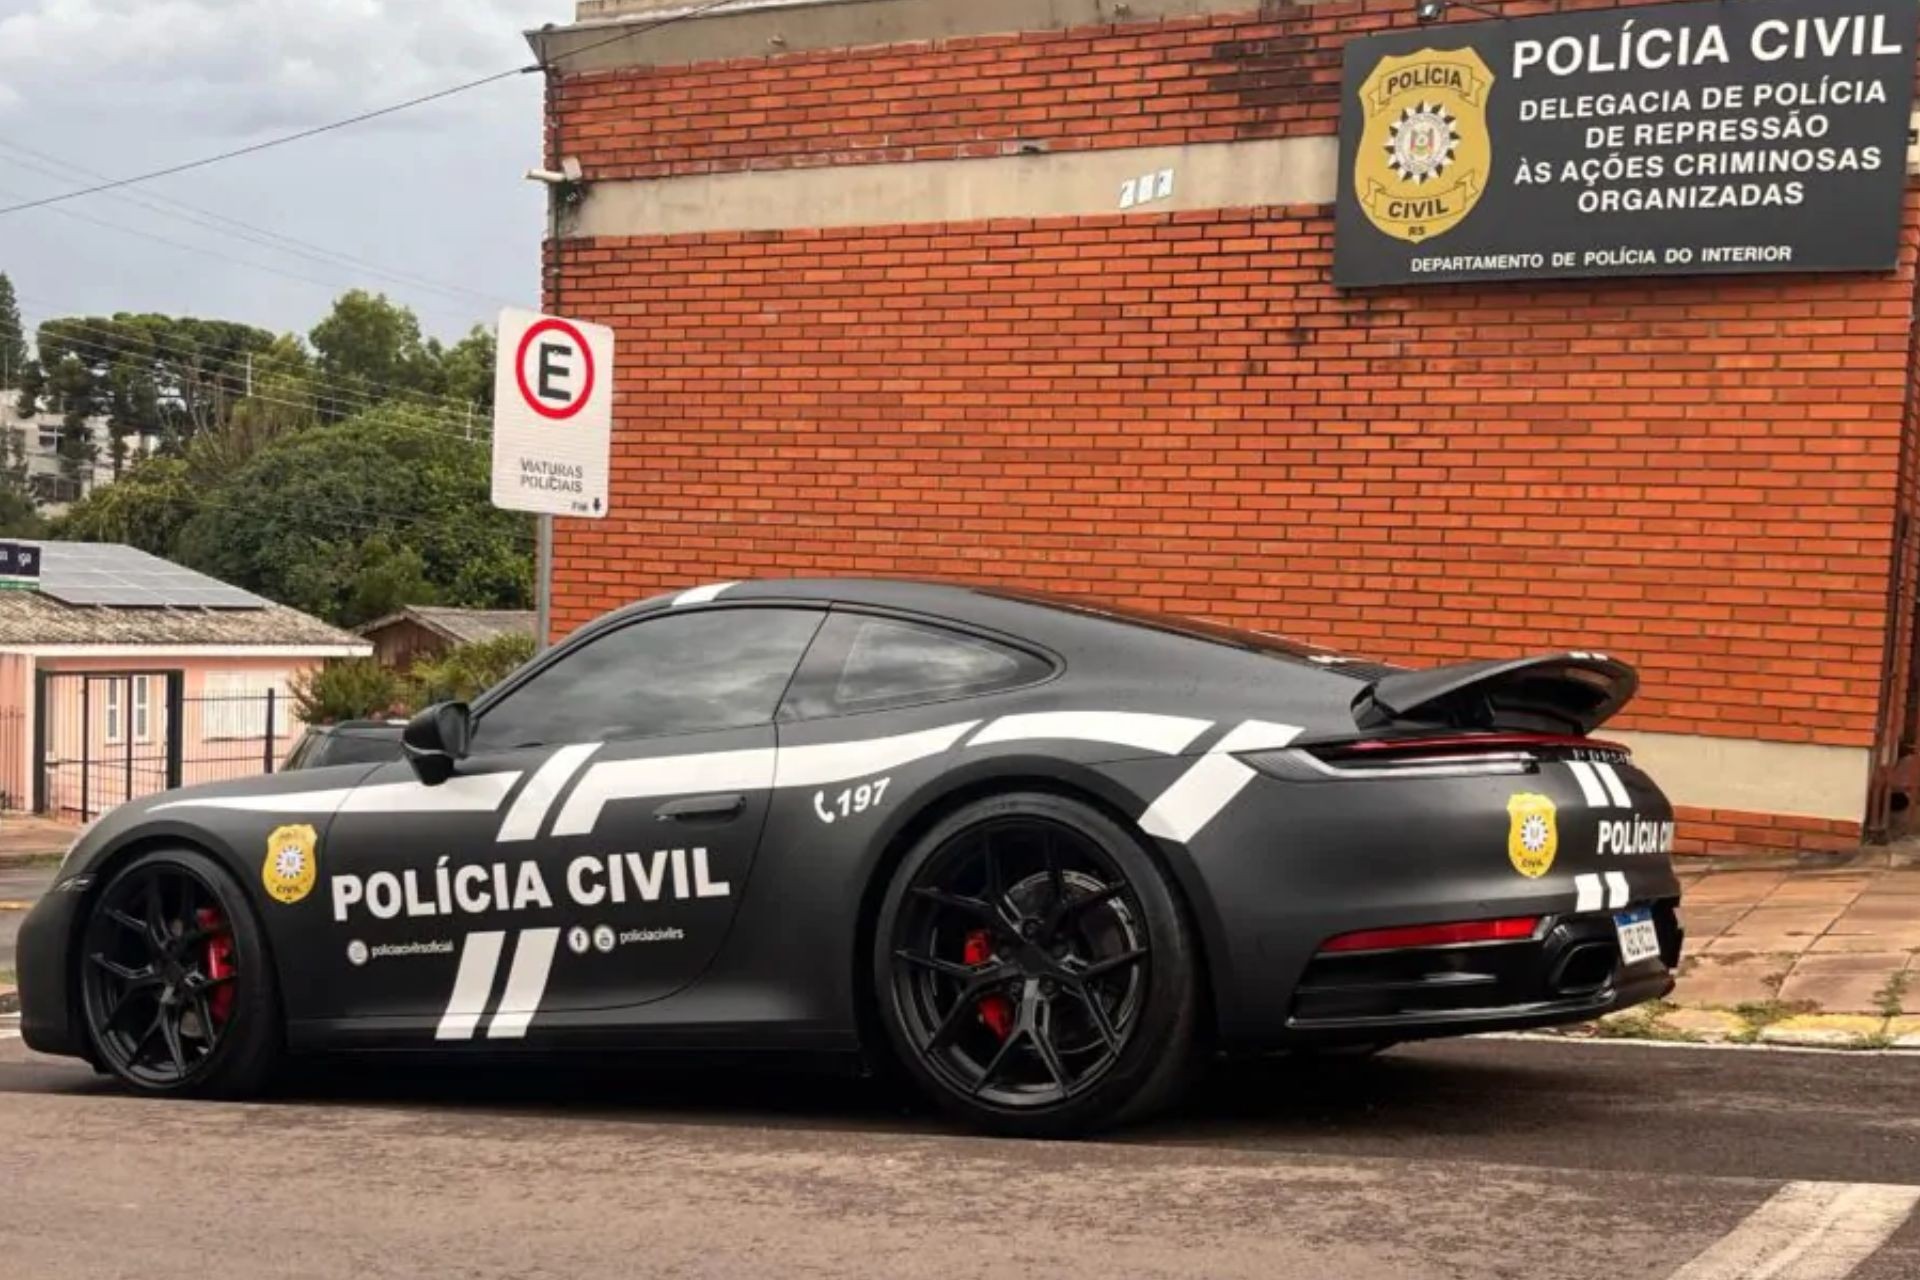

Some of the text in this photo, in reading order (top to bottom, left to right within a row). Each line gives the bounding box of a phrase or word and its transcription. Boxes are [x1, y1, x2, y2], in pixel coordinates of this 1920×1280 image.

[1512, 14, 1902, 79] POLÍCIA CIVIL
[1387, 65, 1463, 95] POLÍCIA
[1519, 74, 1886, 120] DELEGACIA DE POLÍCIA
[1585, 110, 1829, 149] DE REPRESSÃO
[1514, 146, 1881, 187] ÀS AÇÕES CRIMINOSAS
[1388, 198, 1449, 219] CIVIL
[1578, 181, 1804, 213] ORGANIZADAS
[1408, 226, 1426, 237] RS
[1411, 245, 1792, 273] DEPARTAMENTO DE POLÍCIA DO INTERIOR
[538, 342, 572, 402] E
[520, 457, 583, 479] VIATURAS
[836, 776, 891, 817] 197
[1597, 813, 1657, 855] POLÍCIA
[331, 847, 731, 921] POLÍCIA CIVIL
